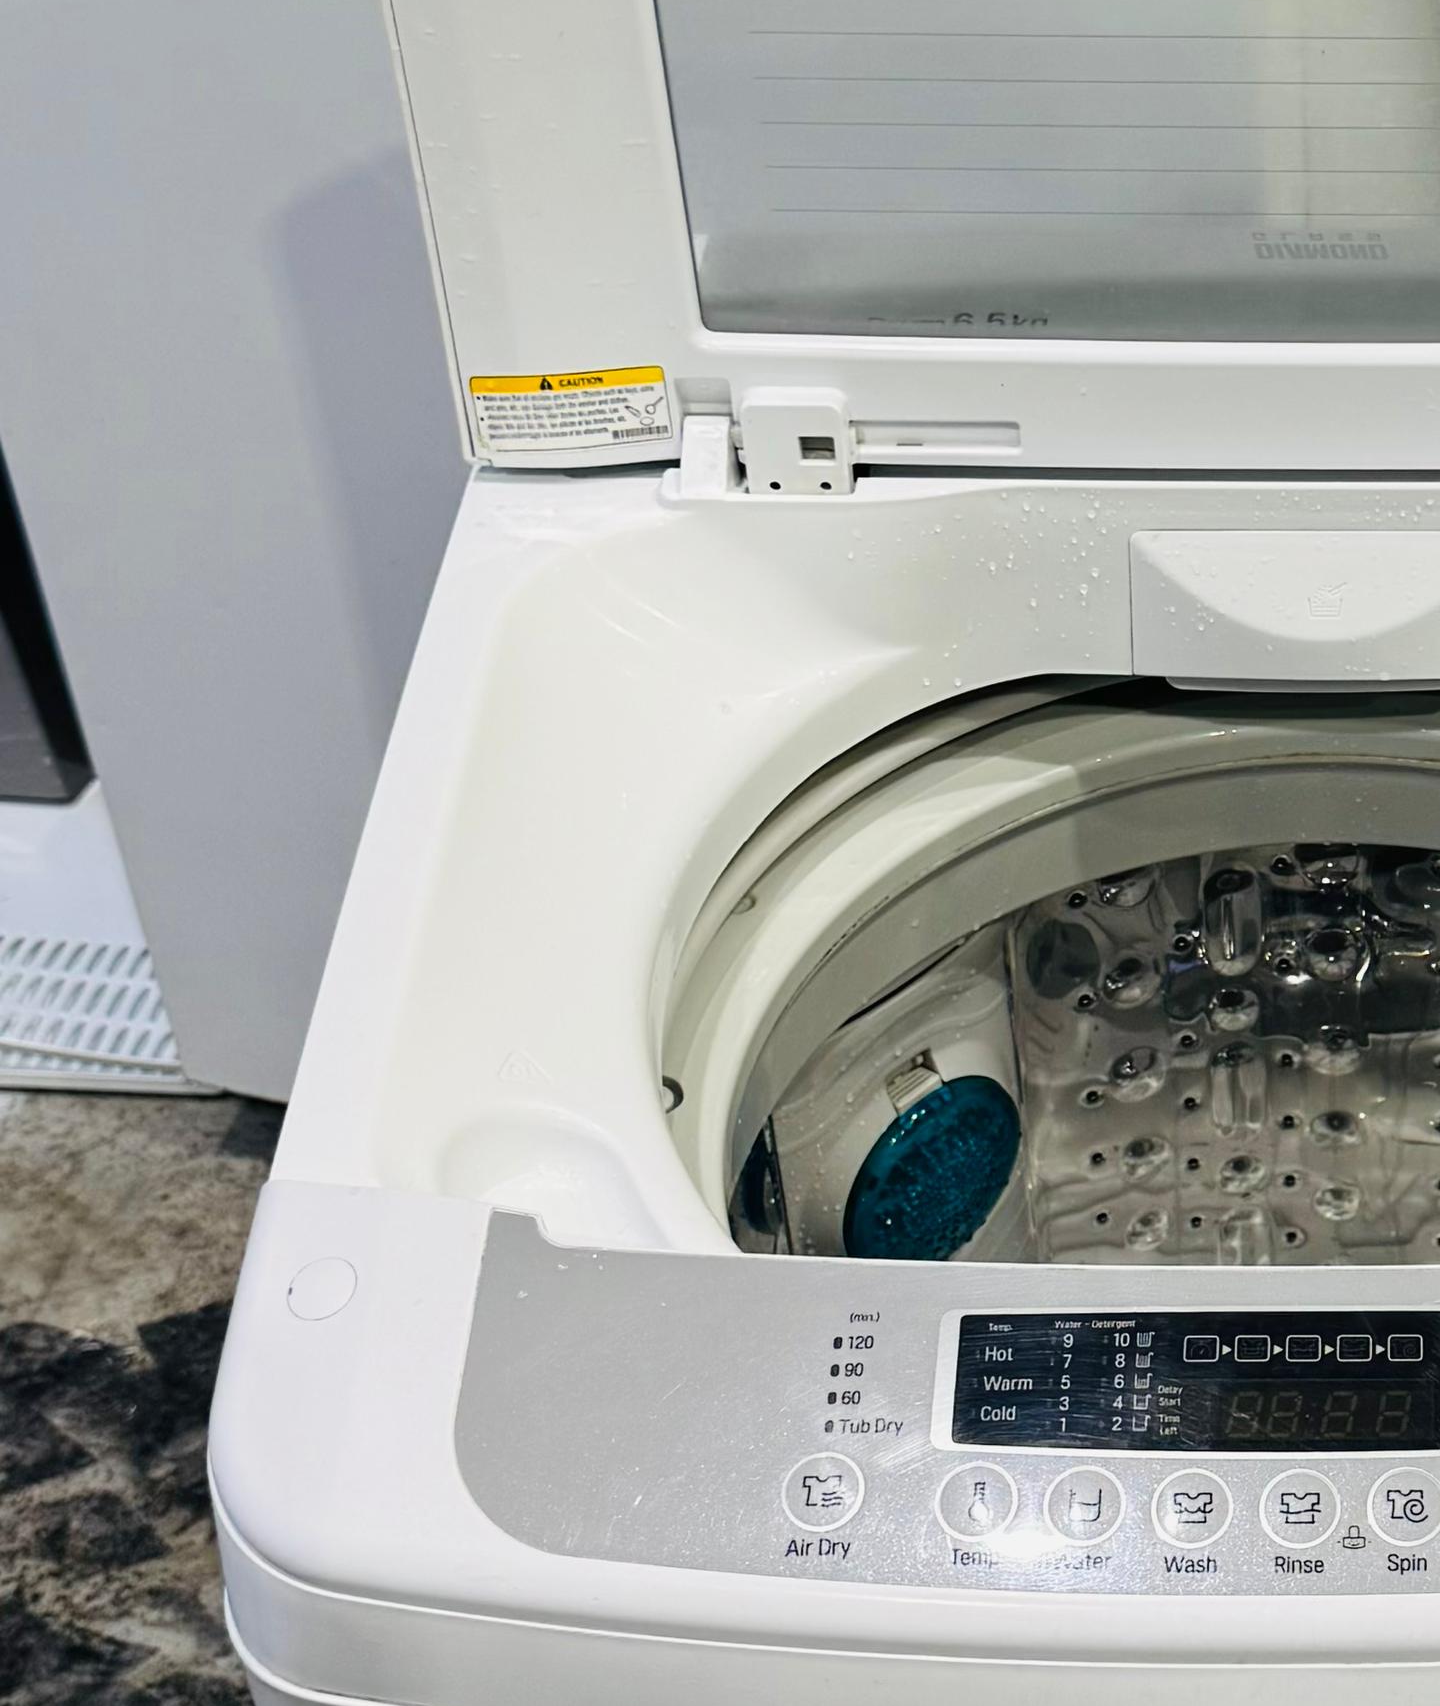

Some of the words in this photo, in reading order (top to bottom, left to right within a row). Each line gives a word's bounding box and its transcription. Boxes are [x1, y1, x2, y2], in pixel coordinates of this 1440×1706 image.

[558, 376, 604, 388] CAUTION
[848, 1335, 874, 1349] 120
[1063, 1333, 1074, 1348] 9
[1113, 1332, 1130, 1347] 10
[985, 1346, 1014, 1362] Hot
[1063, 1354, 1072, 1369] 7
[1115, 1353, 1126, 1368] 8
[844, 1362, 864, 1377] 90
[983, 1376, 1033, 1391] Warm
[1060, 1375, 1071, 1390] 5
[1114, 1374, 1125, 1389] 6
[841, 1390, 861, 1405] 60
[1059, 1396, 1070, 1411] 3
[1112, 1395, 1123, 1409] 4
[980, 1405, 1017, 1422] Cold
[839, 1418, 870, 1434] Tub
[875, 1418, 904, 1436] Dry
[1059, 1418, 1066, 1432] 1
[1111, 1416, 1123, 1432] 2
[785, 1539, 816, 1557] Air
[818, 1538, 851, 1559] Dry
[1163, 1555, 1218, 1574] Wash
[1274, 1556, 1325, 1574] Rinse
[1387, 1555, 1428, 1576] Spin
